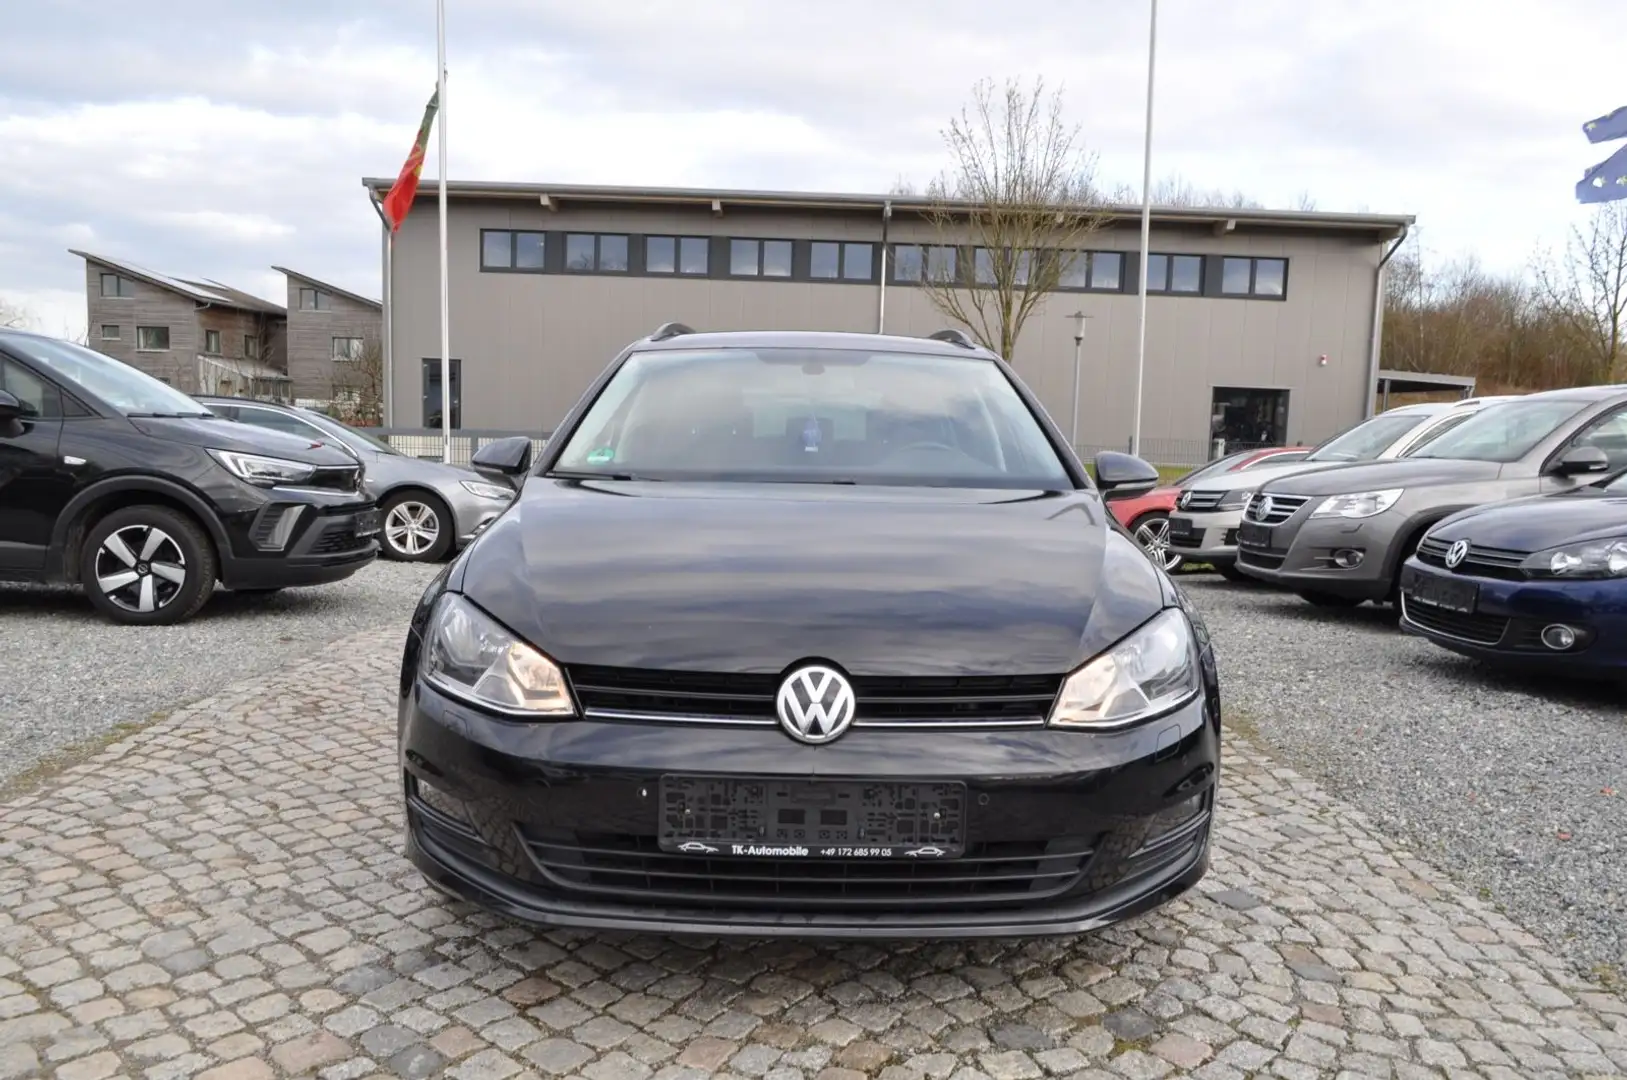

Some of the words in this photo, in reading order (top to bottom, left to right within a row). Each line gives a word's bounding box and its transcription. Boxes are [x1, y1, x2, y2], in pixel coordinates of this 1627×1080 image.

[777, 666, 855, 743] VW
[732, 845, 809, 856] TK-Automobile
[820, 847, 836, 856] +49
[838, 847, 853, 856] 172
[853, 847, 869, 857] 685
[870, 847, 880, 857] 99
[881, 848, 892, 857] 05
